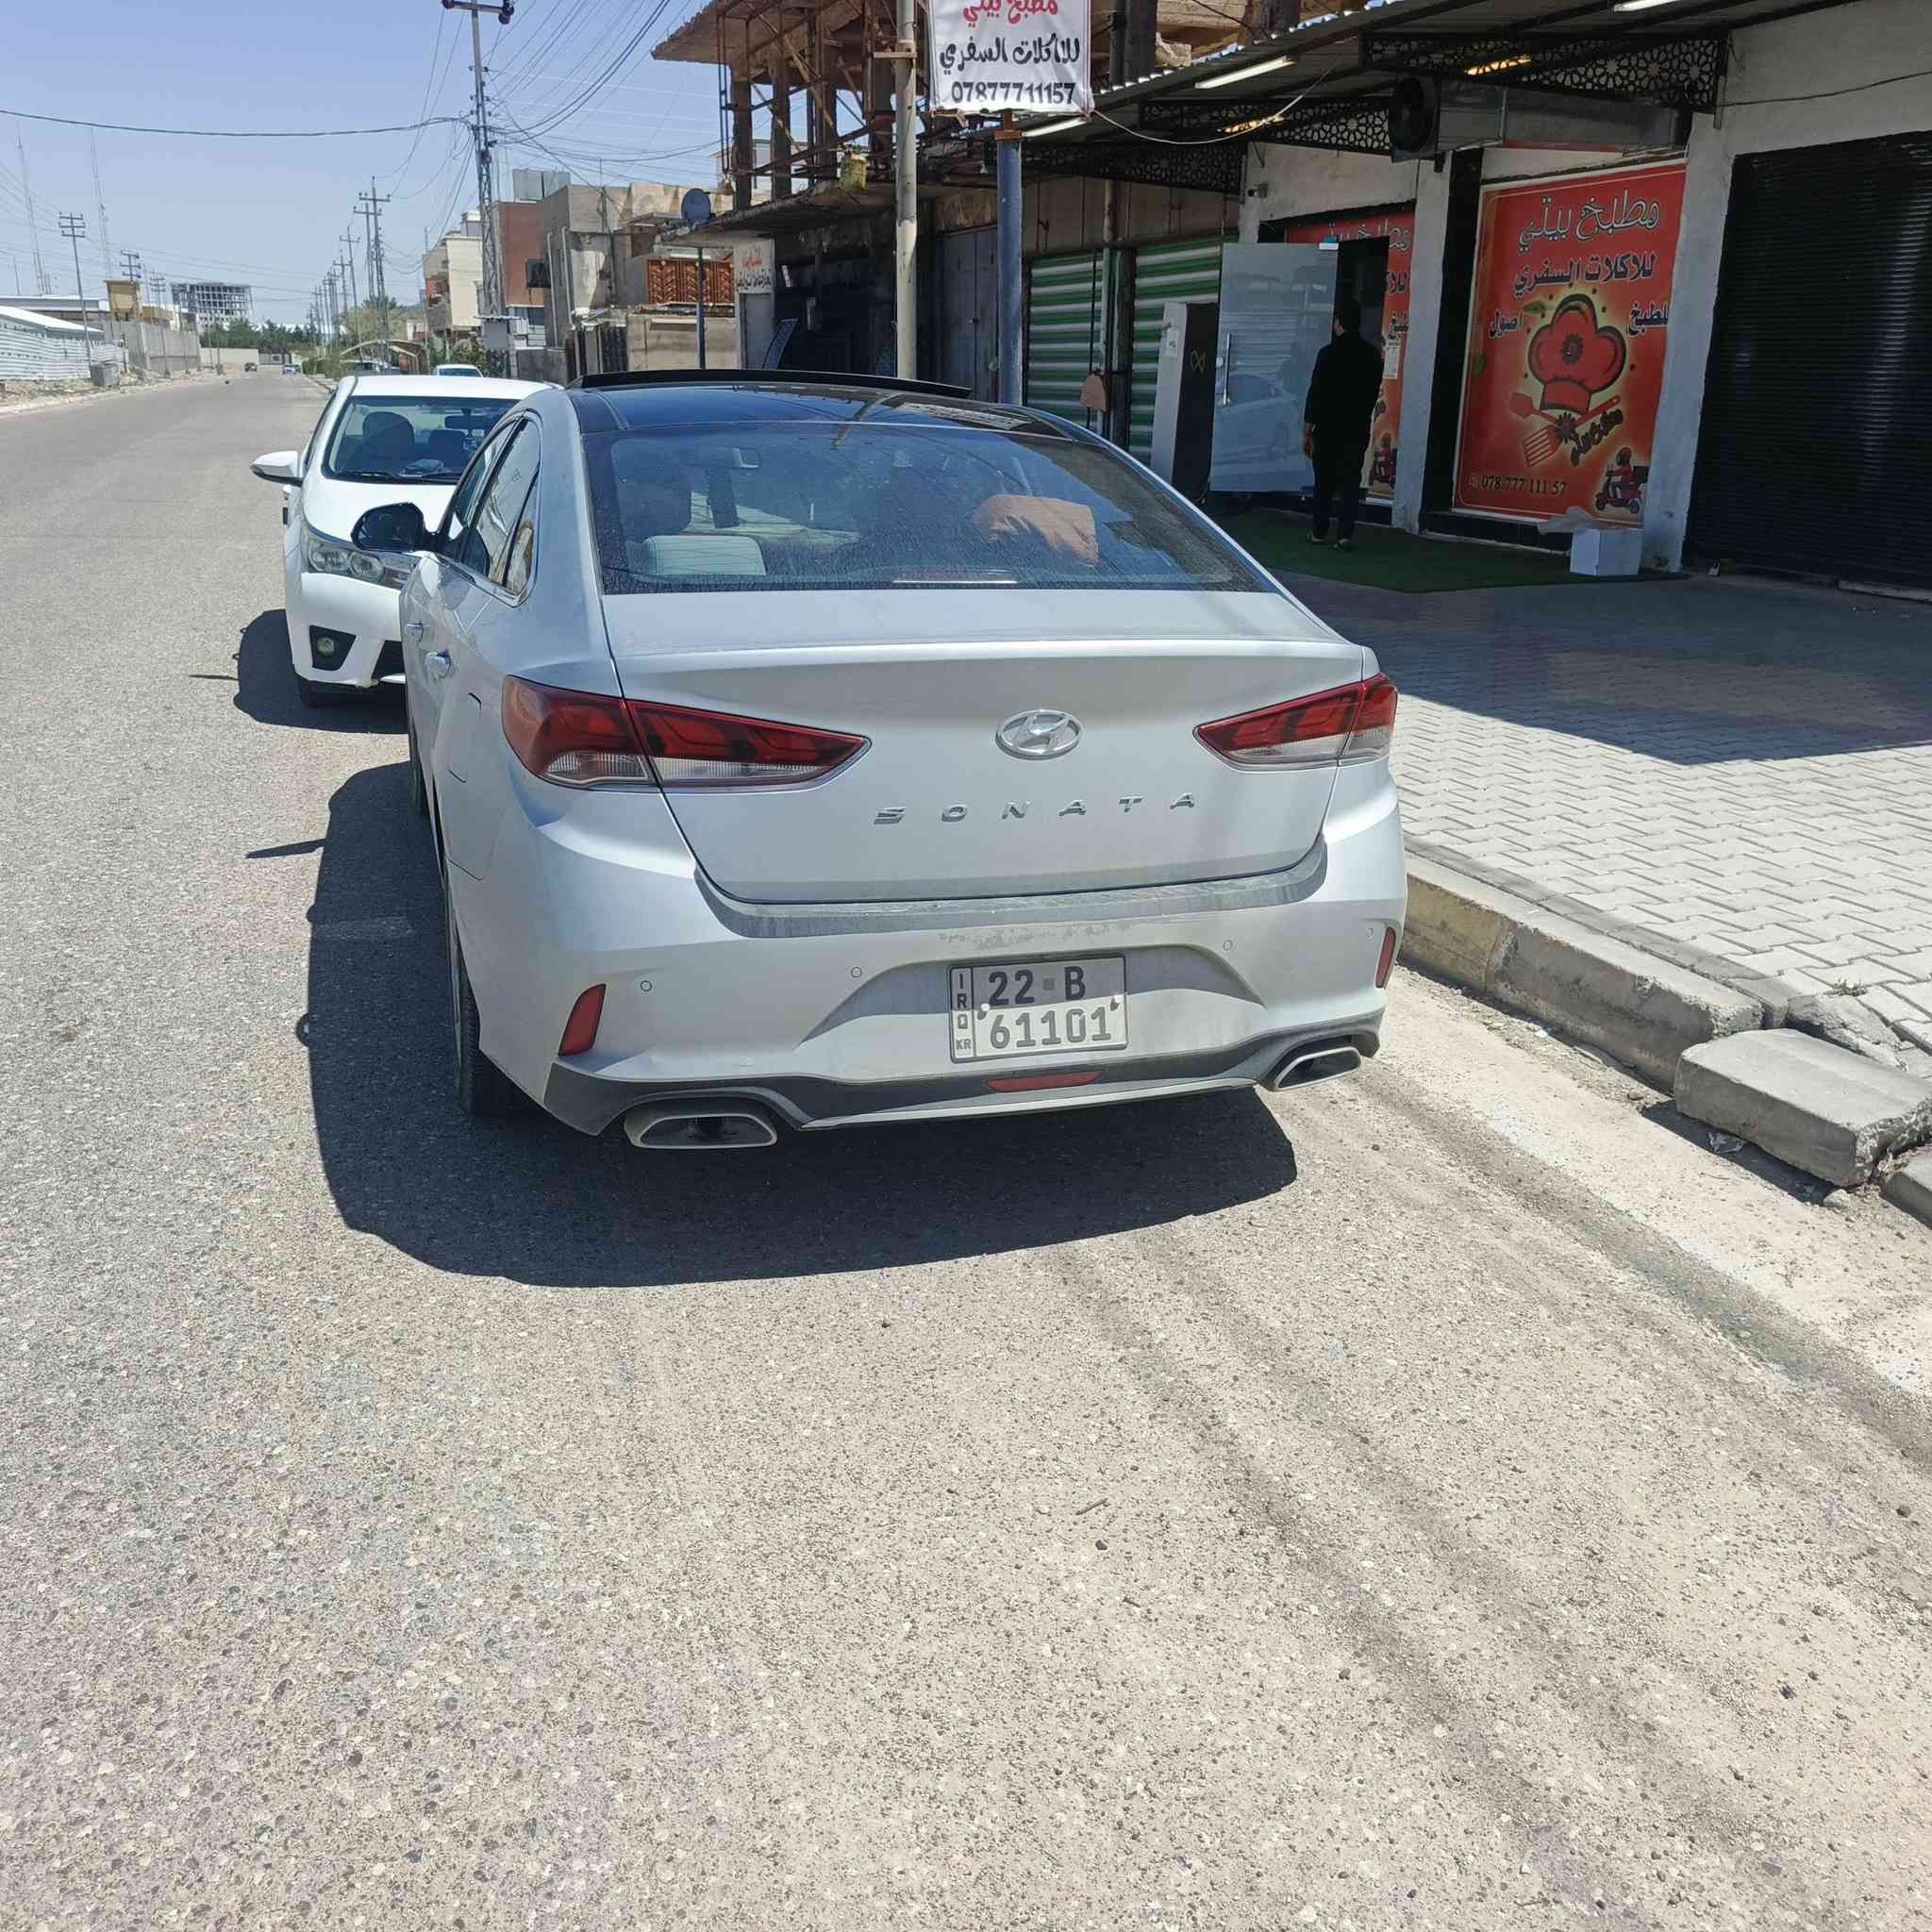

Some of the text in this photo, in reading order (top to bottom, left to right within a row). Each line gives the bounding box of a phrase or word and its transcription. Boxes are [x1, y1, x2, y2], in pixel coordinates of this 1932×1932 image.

[940, 36, 1008, 75] السفري
[951, 81, 1075, 105] 07877711157
[1519, 189, 1661, 252] مطبخ بيتي
[1513, 257, 1582, 299] السفري
[874, 792, 1194, 824] SONATA
[988, 966, 1086, 1007] 22 B
[990, 1006, 1112, 1049] 61101
